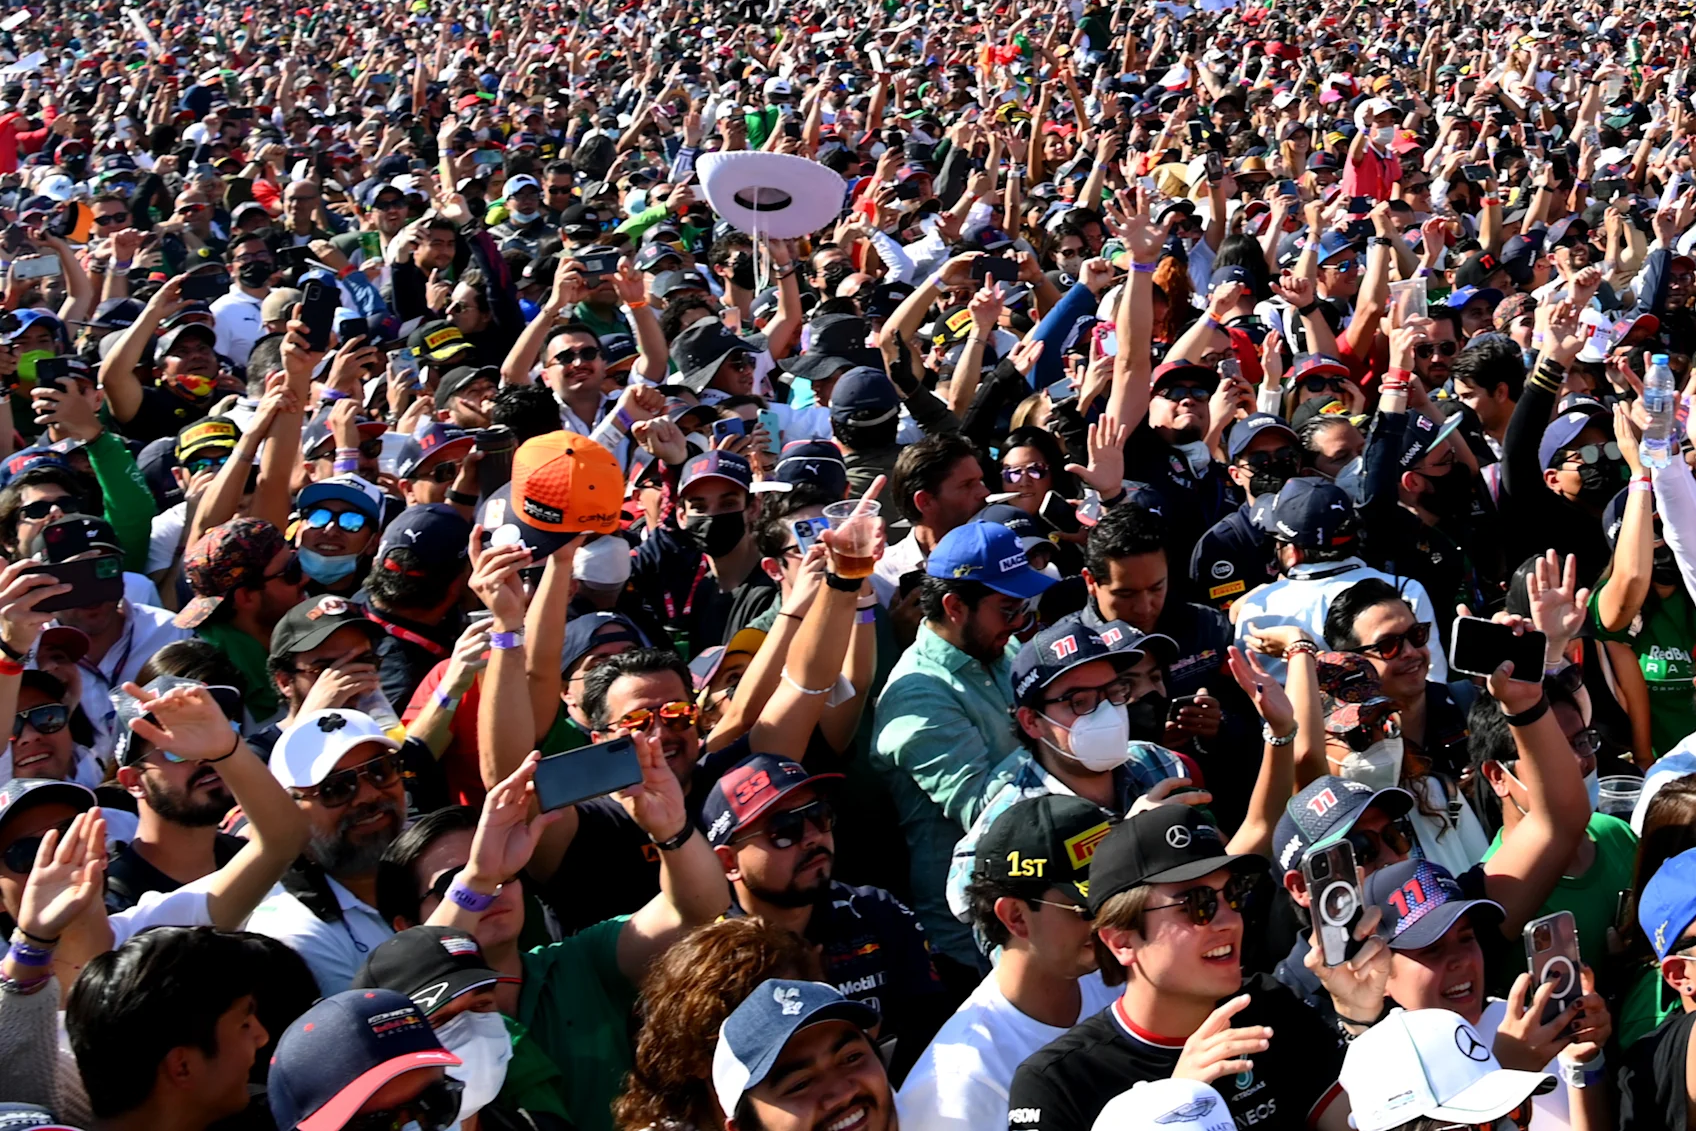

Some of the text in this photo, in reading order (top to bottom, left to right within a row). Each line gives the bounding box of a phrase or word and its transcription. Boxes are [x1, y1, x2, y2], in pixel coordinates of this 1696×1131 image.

[1050, 634, 1078, 660] 11
[1101, 627, 1123, 647] 11
[736, 770, 771, 805] 33
[1307, 787, 1339, 817] 11
[1007, 851, 1048, 878] 1ST
[1388, 878, 1426, 917] 11
[839, 974, 876, 995] Mobil
[1235, 1097, 1277, 1129] NEOS
